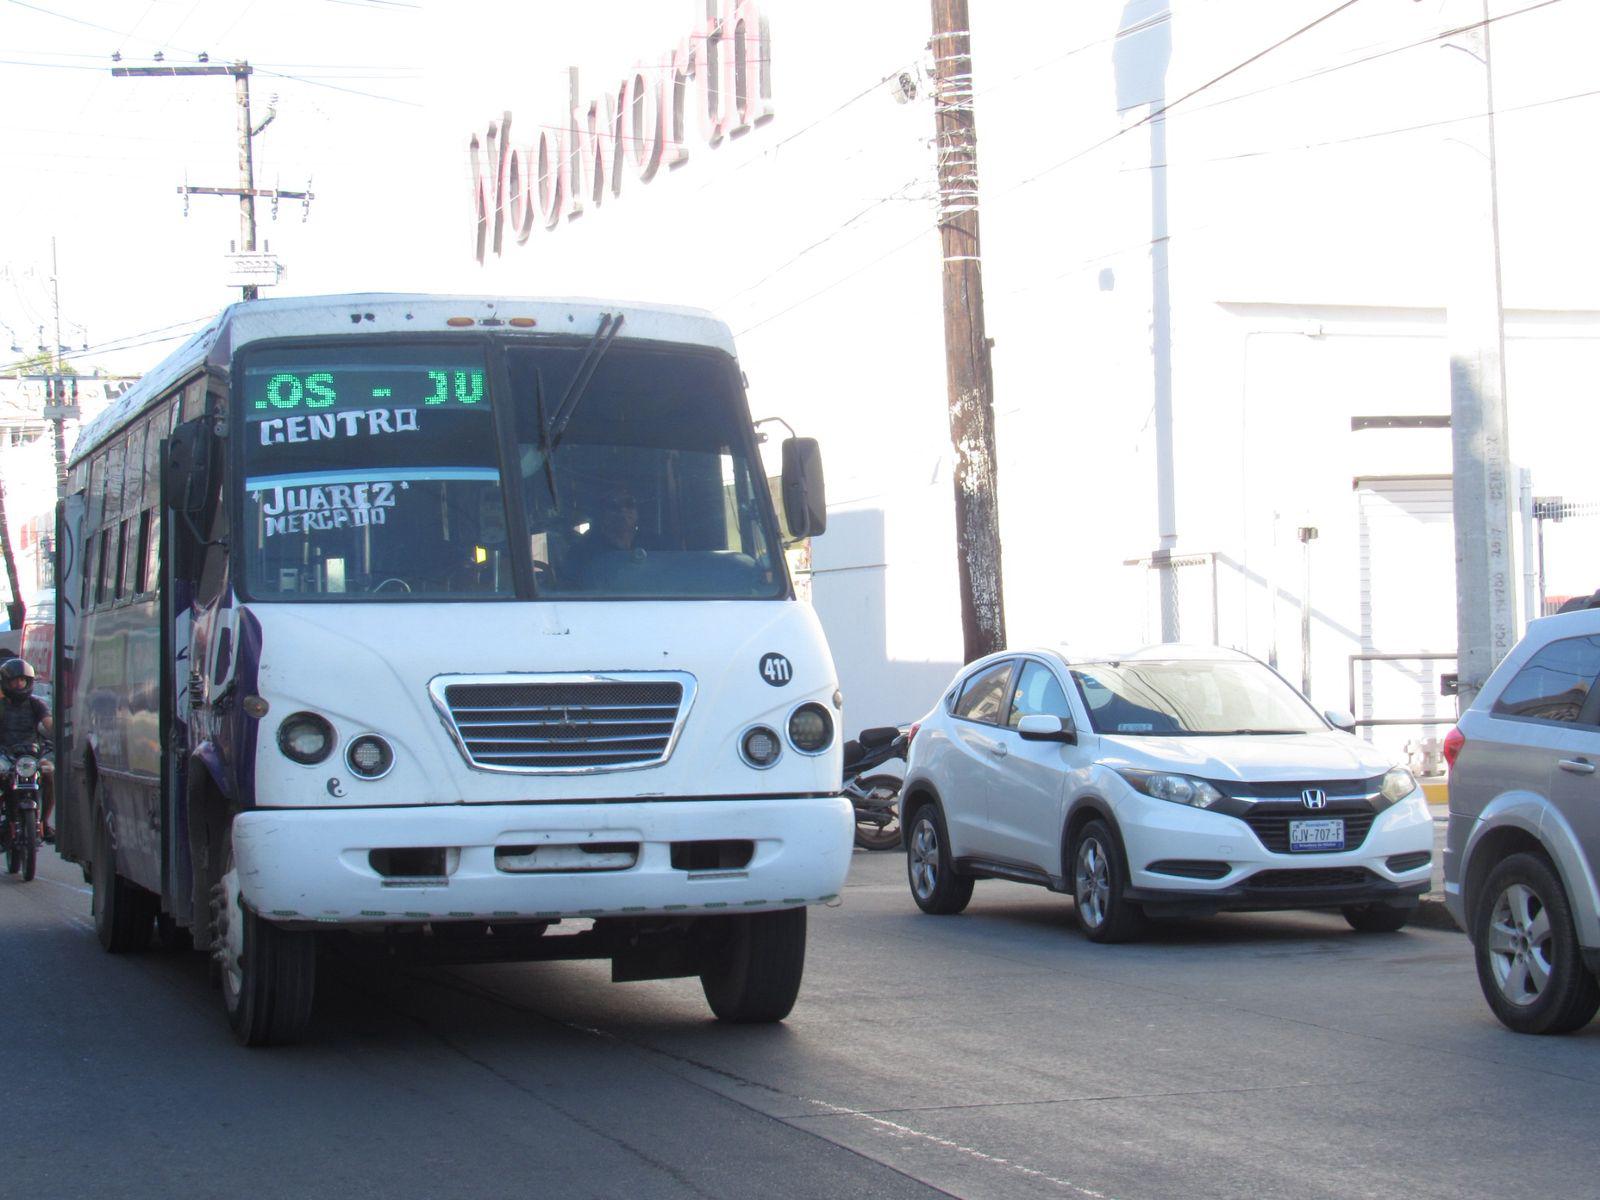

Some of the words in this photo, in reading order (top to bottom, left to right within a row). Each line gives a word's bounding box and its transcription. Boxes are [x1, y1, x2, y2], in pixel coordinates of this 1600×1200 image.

[255, 373, 337, 408] OS
[259, 408, 420, 446] CENTRO
[263, 482, 396, 515] JUAREZ
[264, 507, 386, 537] MERCADO
[764, 658, 790, 681] 411
